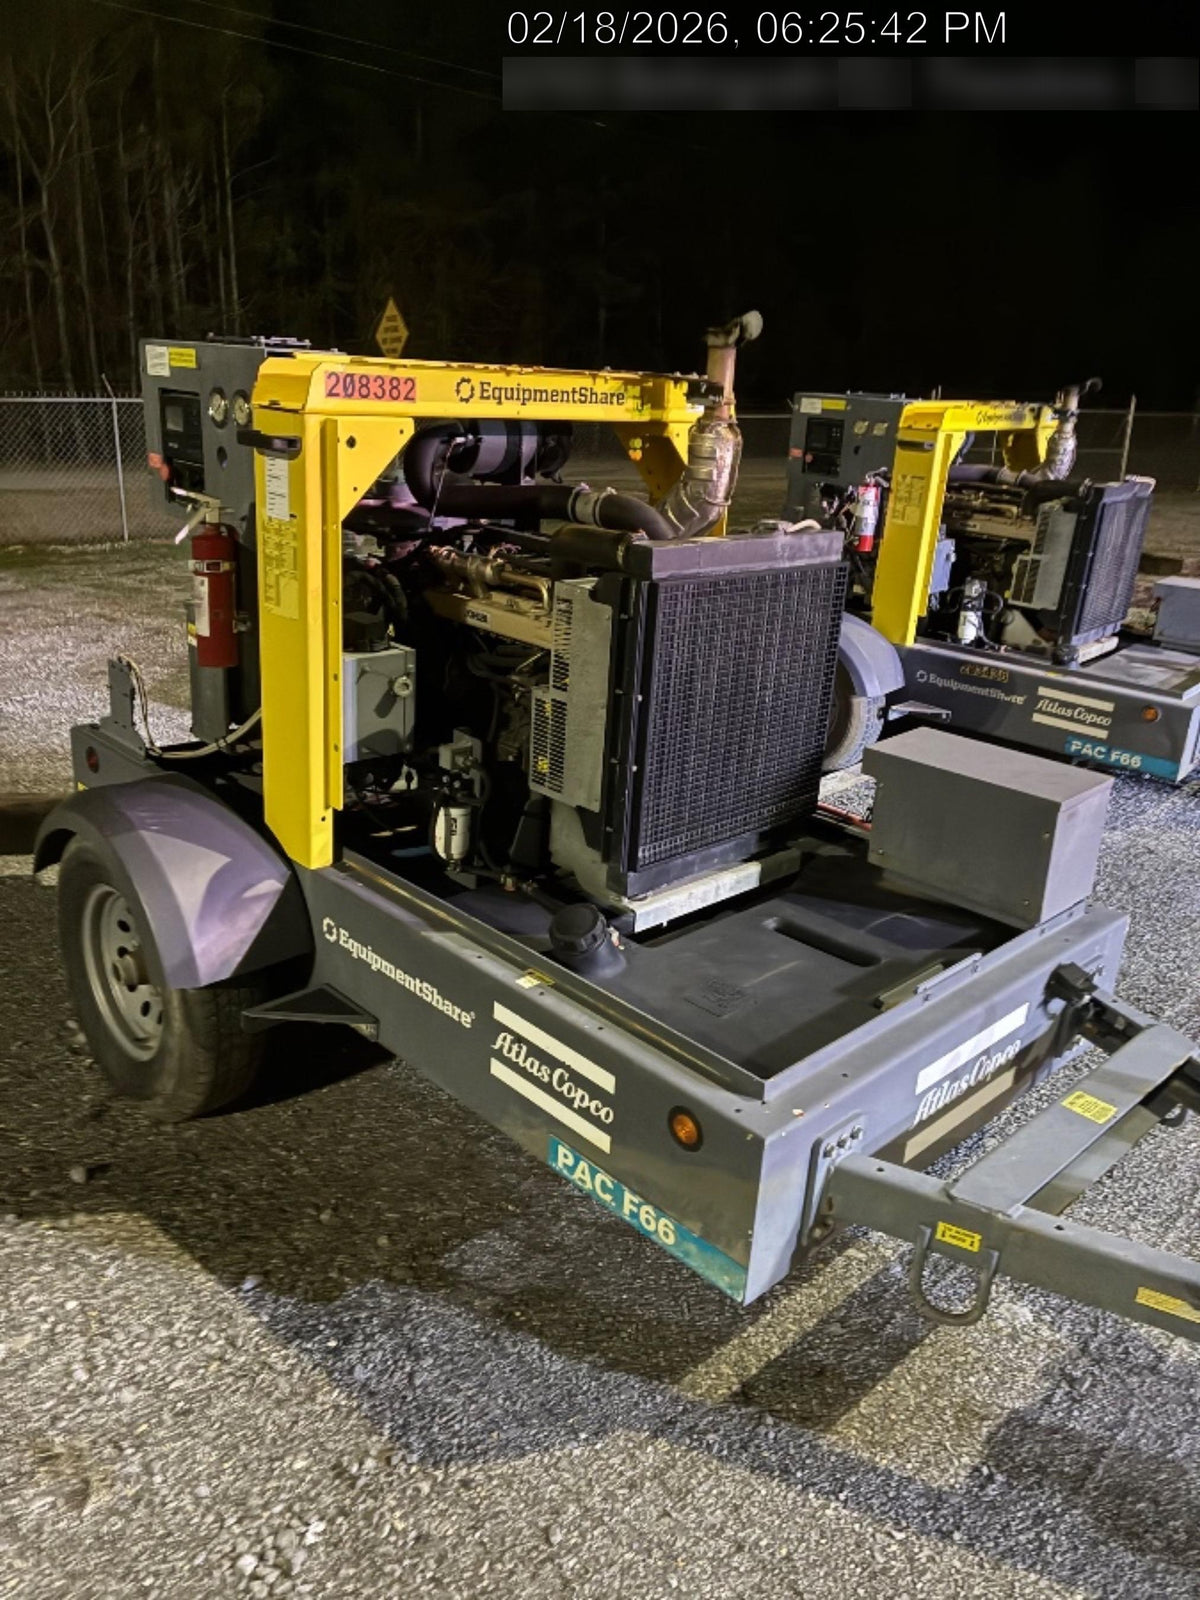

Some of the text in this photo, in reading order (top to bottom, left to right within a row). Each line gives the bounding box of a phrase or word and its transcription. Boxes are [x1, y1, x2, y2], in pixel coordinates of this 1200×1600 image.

[326, 371, 416, 401] 208382
[479, 380, 626, 406] EquipmentShare
[1034, 699, 1112, 726] Atlas Copco
[1069, 740, 1142, 769] PAC F66
[338, 926, 472, 1029] EquipmentShare
[490, 1031, 615, 1125] Atlas Copco
[556, 1143, 678, 1247] PAC F66
